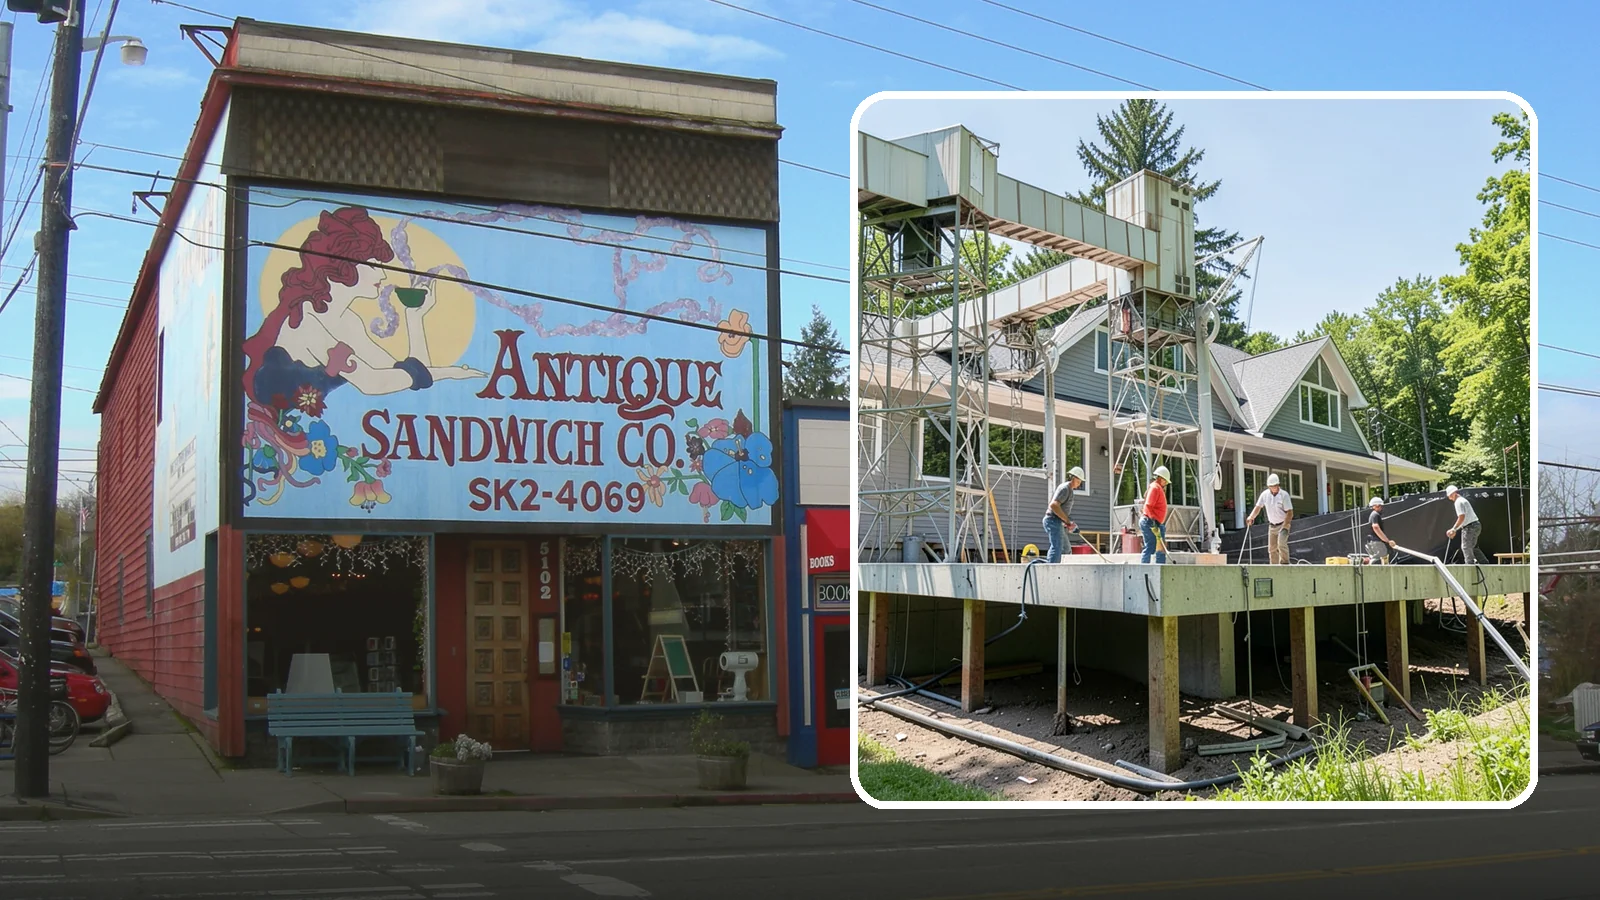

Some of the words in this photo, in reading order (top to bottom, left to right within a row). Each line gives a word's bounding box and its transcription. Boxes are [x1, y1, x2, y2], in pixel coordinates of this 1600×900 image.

[475, 329, 723, 421] ANTIQUE
[361, 408, 604, 467] SANDWICH
[617, 422, 685, 469] CO.
[469, 477, 645, 513] SK2-4069
[540, 541, 551, 600] 5102
[809, 555, 835, 569] BOOKS
